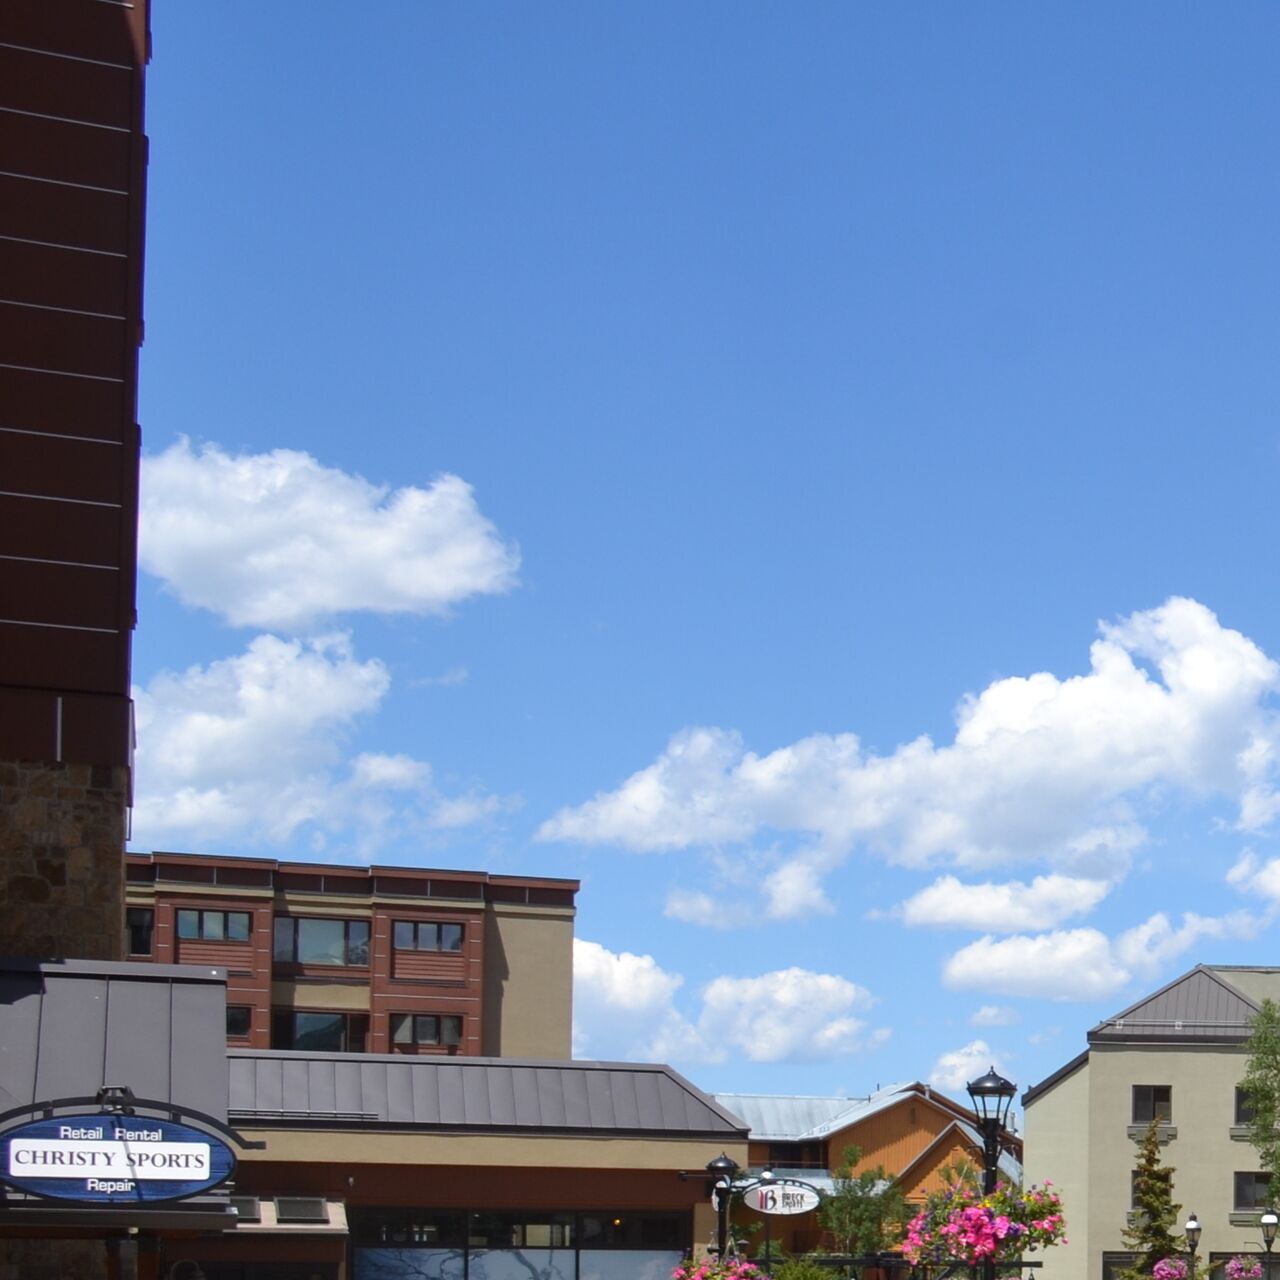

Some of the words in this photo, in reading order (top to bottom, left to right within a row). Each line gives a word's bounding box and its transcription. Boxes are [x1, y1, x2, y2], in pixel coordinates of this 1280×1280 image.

[60, 1126, 103, 1139] Retail
[115, 1128, 162, 1141] Rental
[15, 1150, 115, 1166] CHRISTY
[126, 1152, 205, 1169] SPORTS
[87, 1179, 136, 1194] Repair
